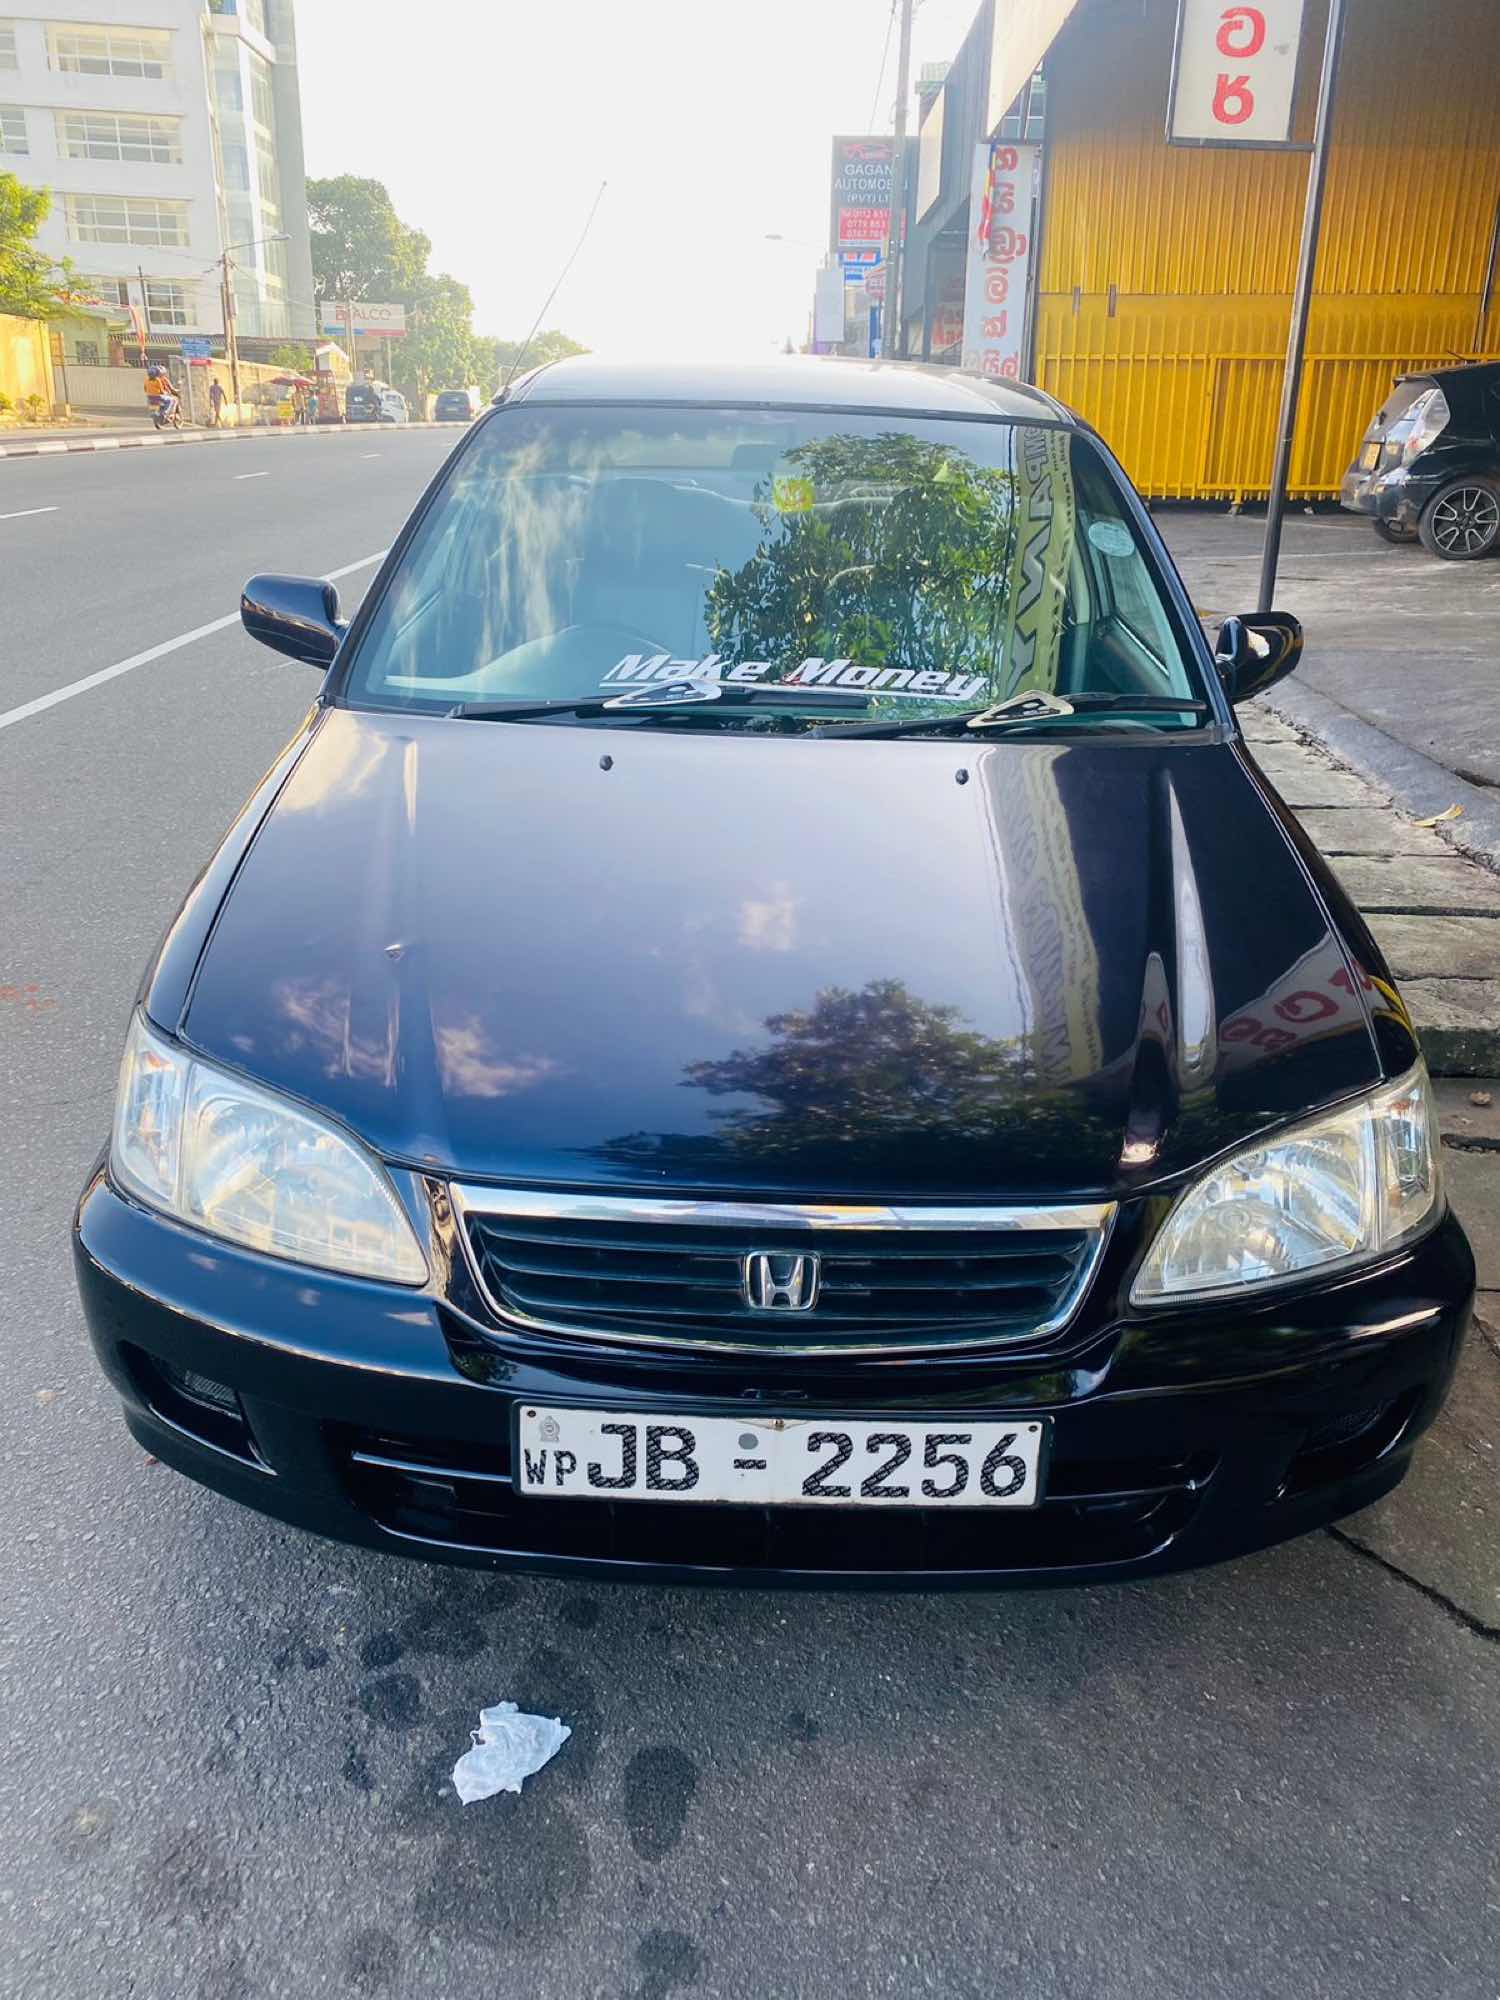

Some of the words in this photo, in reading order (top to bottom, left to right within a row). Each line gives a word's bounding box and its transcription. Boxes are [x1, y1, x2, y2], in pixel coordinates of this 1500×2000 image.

[844, 163, 893, 176] GAGAN
[603, 654, 771, 682] Make
[789, 657, 988, 699] Money
[523, 1448, 577, 1486] WP
[587, 1423, 700, 1491] JB
[802, 1430, 1028, 1499] 2256
